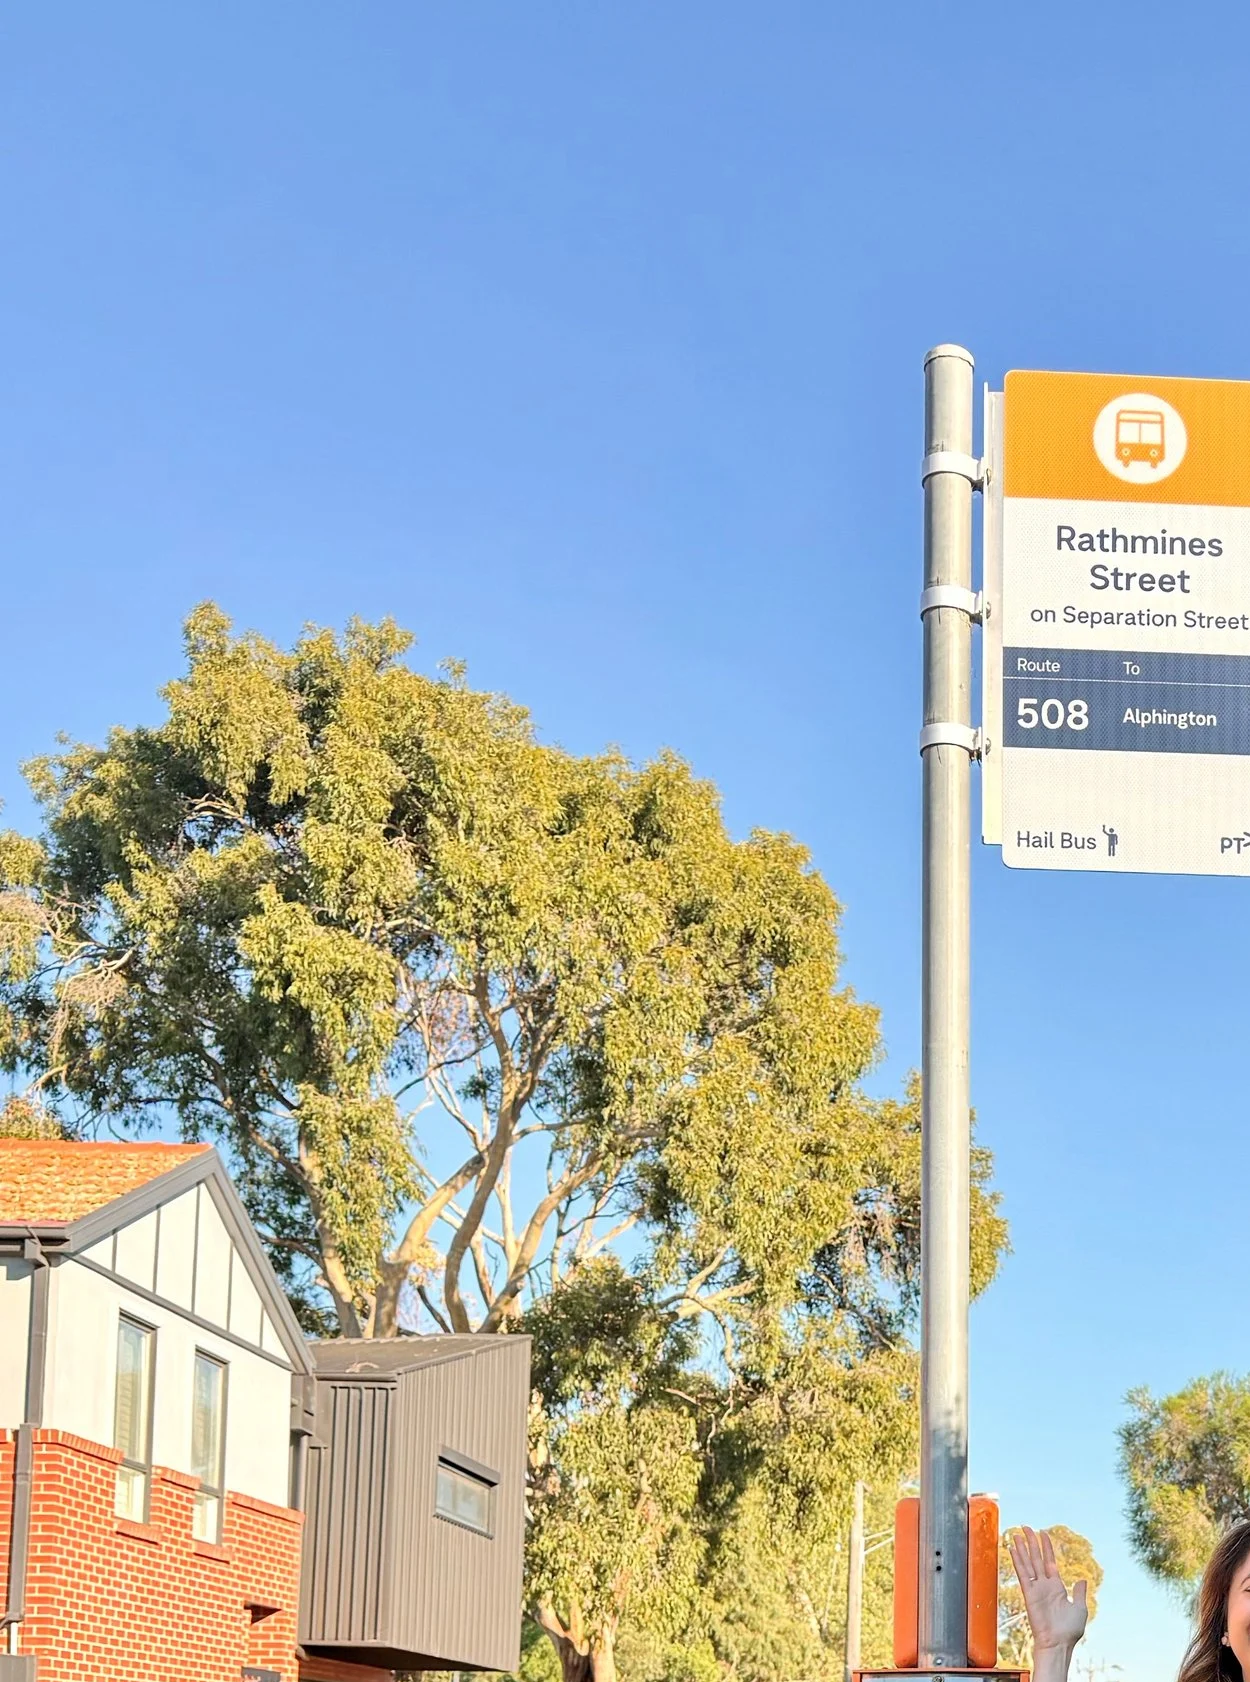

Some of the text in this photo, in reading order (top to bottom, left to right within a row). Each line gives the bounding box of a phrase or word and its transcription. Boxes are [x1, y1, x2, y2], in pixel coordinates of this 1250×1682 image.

[1056, 525, 1223, 557] Rathmines
[1090, 564, 1190, 593] Street
[1030, 606, 1249, 630] on Separation Street
[1017, 658, 1060, 673] Route
[1123, 661, 1140, 675] To
[1017, 698, 1089, 730] 508
[1122, 708, 1217, 729] Alphington
[1017, 830, 1097, 850] Hail Bus
